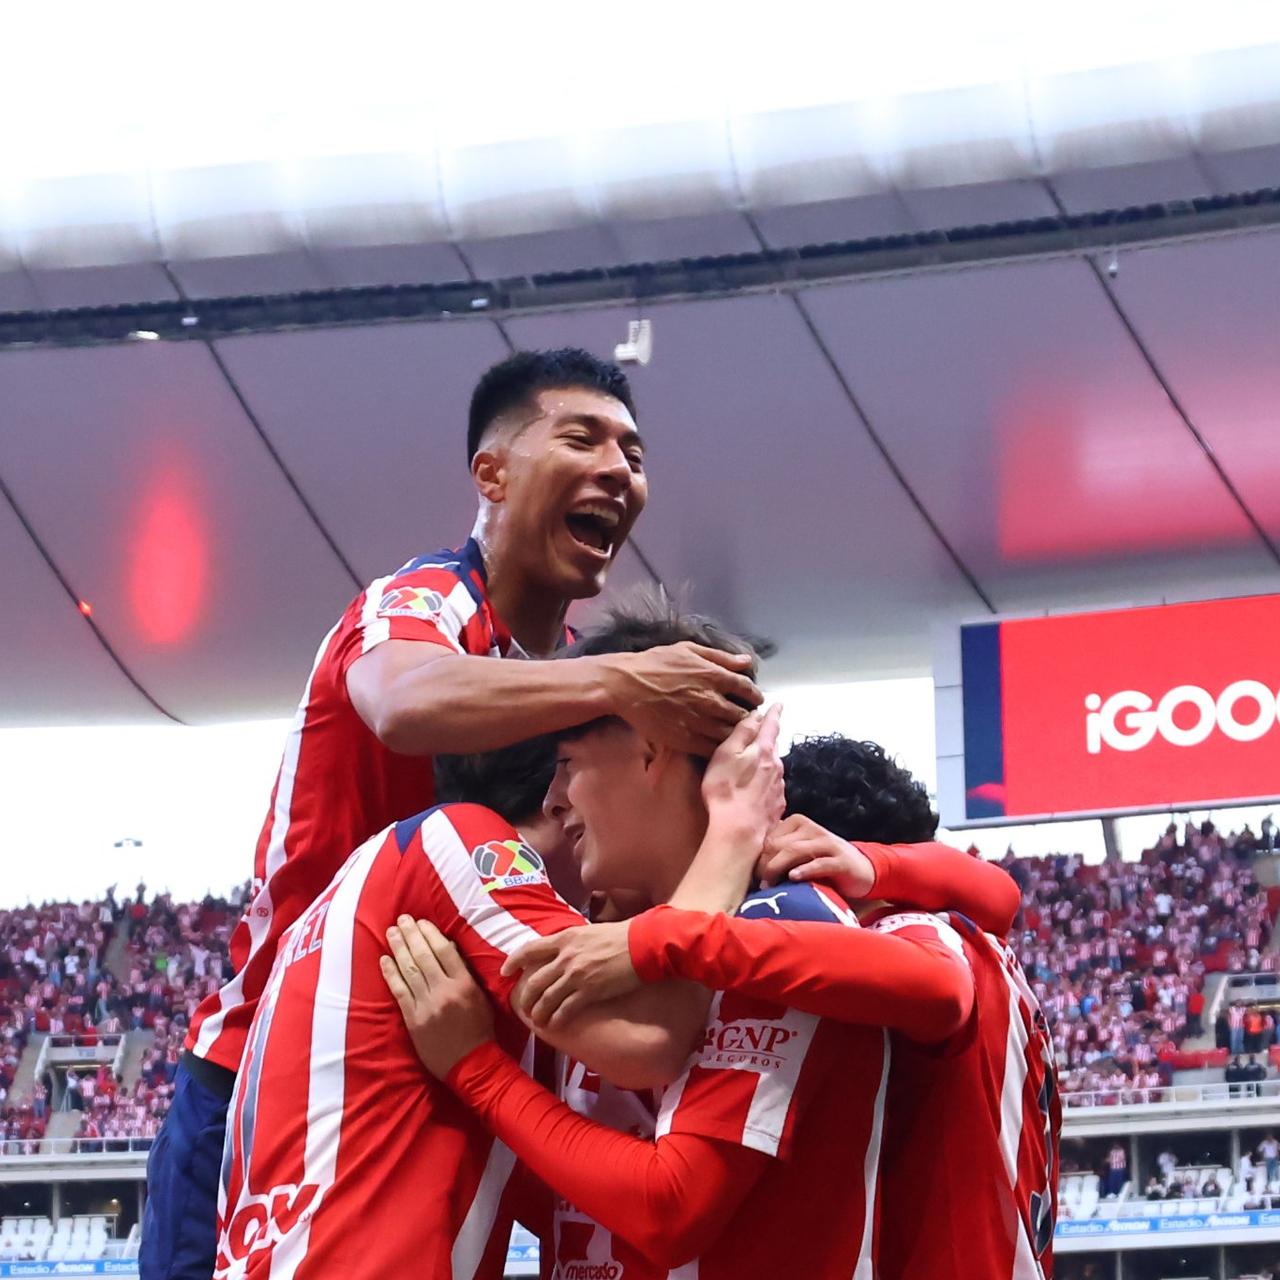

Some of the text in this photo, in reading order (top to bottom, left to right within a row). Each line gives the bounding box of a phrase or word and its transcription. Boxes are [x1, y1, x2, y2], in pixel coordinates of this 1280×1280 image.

[717, 1026, 791, 1053] GNP
[706, 1053, 782, 1069] SEGUROS
[1061, 1222, 1104, 1234] Estadio
[1160, 1217, 1203, 1229] Estadio
[10, 1264, 49, 1275] Estadio
[566, 1261, 618, 1280] mercado
